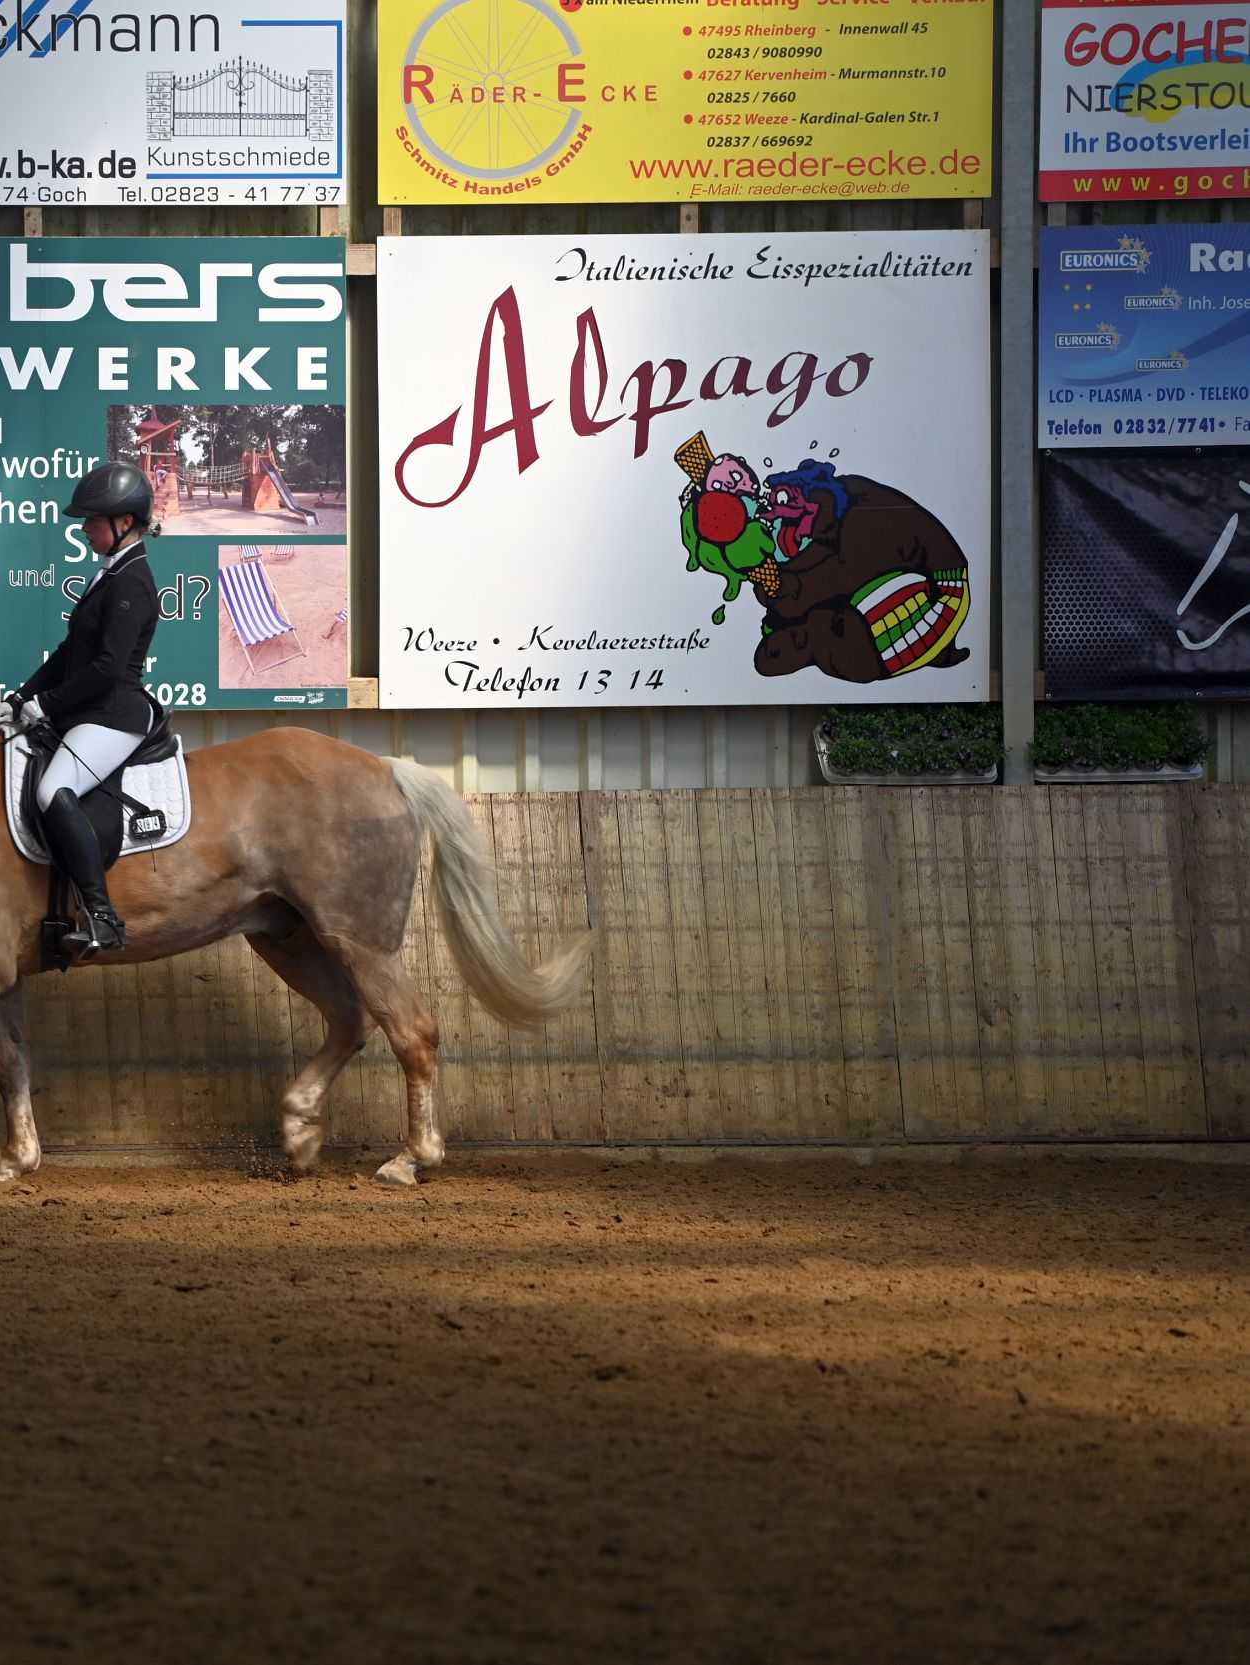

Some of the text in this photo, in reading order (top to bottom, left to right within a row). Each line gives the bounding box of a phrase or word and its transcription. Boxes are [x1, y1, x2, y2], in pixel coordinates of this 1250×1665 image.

[698, 25, 741, 37] 47495
[744, 24, 816, 38] Rheinberg
[839, 23, 908, 35] Innenwall
[911, 23, 929, 34] 45
[1064, 18, 1250, 67] GOCHE
[707, 47, 750, 59] 02843
[761, 46, 823, 58] 9080990
[698, 70, 741, 81] 47627
[744, 69, 827, 81] Kervenheim
[707, 91, 750, 104] 02825
[762, 91, 796, 103] 7660
[698, 114, 741, 126] 47652
[744, 113, 789, 125] Weeze
[799, 111, 905, 125] Kardinal-Galen
[706, 135, 750, 149] 02837
[761, 135, 813, 147] 669692
[1064, 131, 1099, 153] Ihr
[147, 146, 330, 167] Kunstschmiede
[395, 123, 592, 195] Schmitz Handels GmbH
[629, 149, 981, 179] www.raeder-ecke.de
[37, 186, 87, 202] Goch
[244, 186, 267, 202] 41
[280, 186, 305, 202] 77
[315, 186, 341, 202] 37
[691, 181, 910, 196] E-Mail: raeder-ecke@web.de
[1065, 253, 1138, 268] EURONICS
[1190, 242, 1250, 272] Ra
[555, 246, 974, 286] Italienische Eisspezialitäten
[1188, 297, 1216, 310] Inh.
[1058, 334, 1112, 346] EURONICS
[395, 285, 875, 509] Alpago
[1049, 389, 1074, 403] LCD
[1089, 387, 1143, 402] PLASMA
[1157, 387, 1186, 400] DVD
[1047, 420, 1102, 435] Telefon
[2, 448, 100, 478] wofür
[8, 564, 55, 587] und
[401, 627, 478, 652] Weeze
[444, 660, 664, 700] Telefon 13 14
